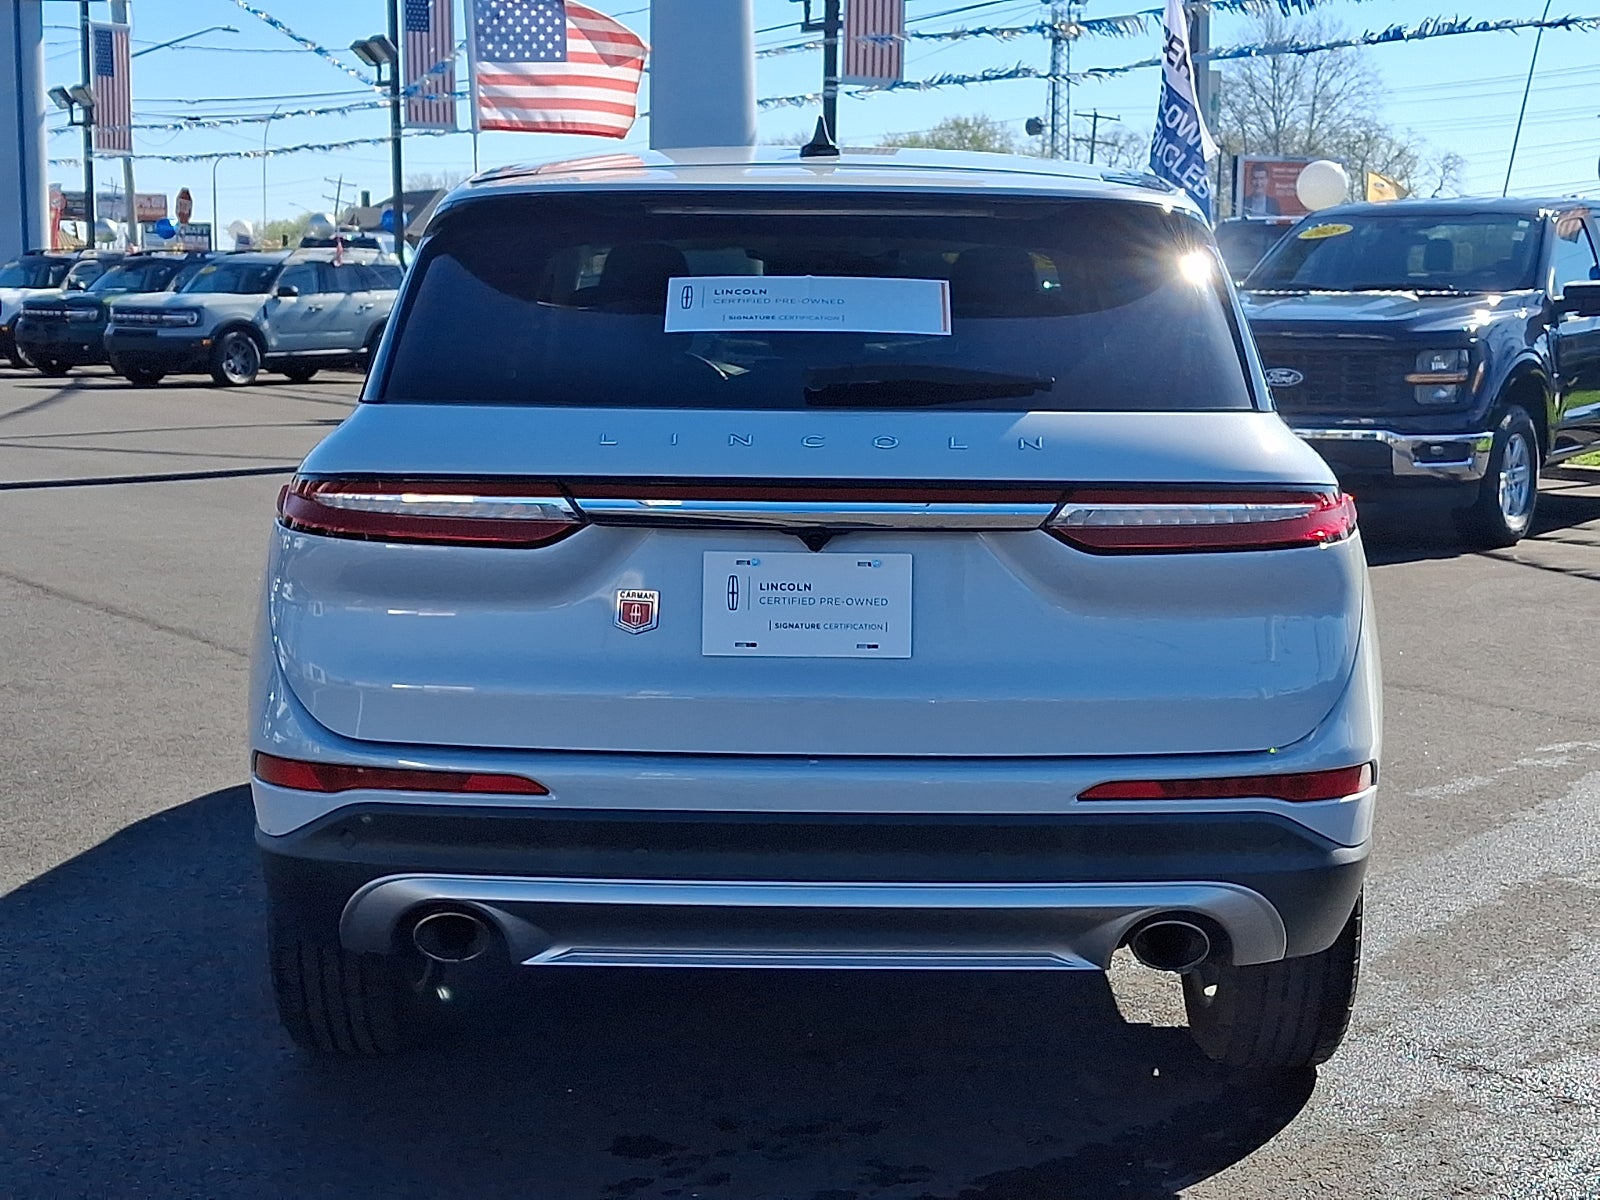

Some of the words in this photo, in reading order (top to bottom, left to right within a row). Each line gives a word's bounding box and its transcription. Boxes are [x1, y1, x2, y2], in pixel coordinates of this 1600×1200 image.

[714, 288, 768, 296] LINCOLN
[713, 297, 771, 305] CERTIFIED
[599, 432, 1044, 450] LINCOLN
[759, 582, 812, 592] LINCOLN
[620, 591, 654, 600] CARMAN
[759, 596, 816, 606] CERTIFIED
[819, 597, 889, 607] PRE-OWNED
[774, 622, 821, 630] SIGNATURE
[823, 622, 883, 631] CERTIFICATION
